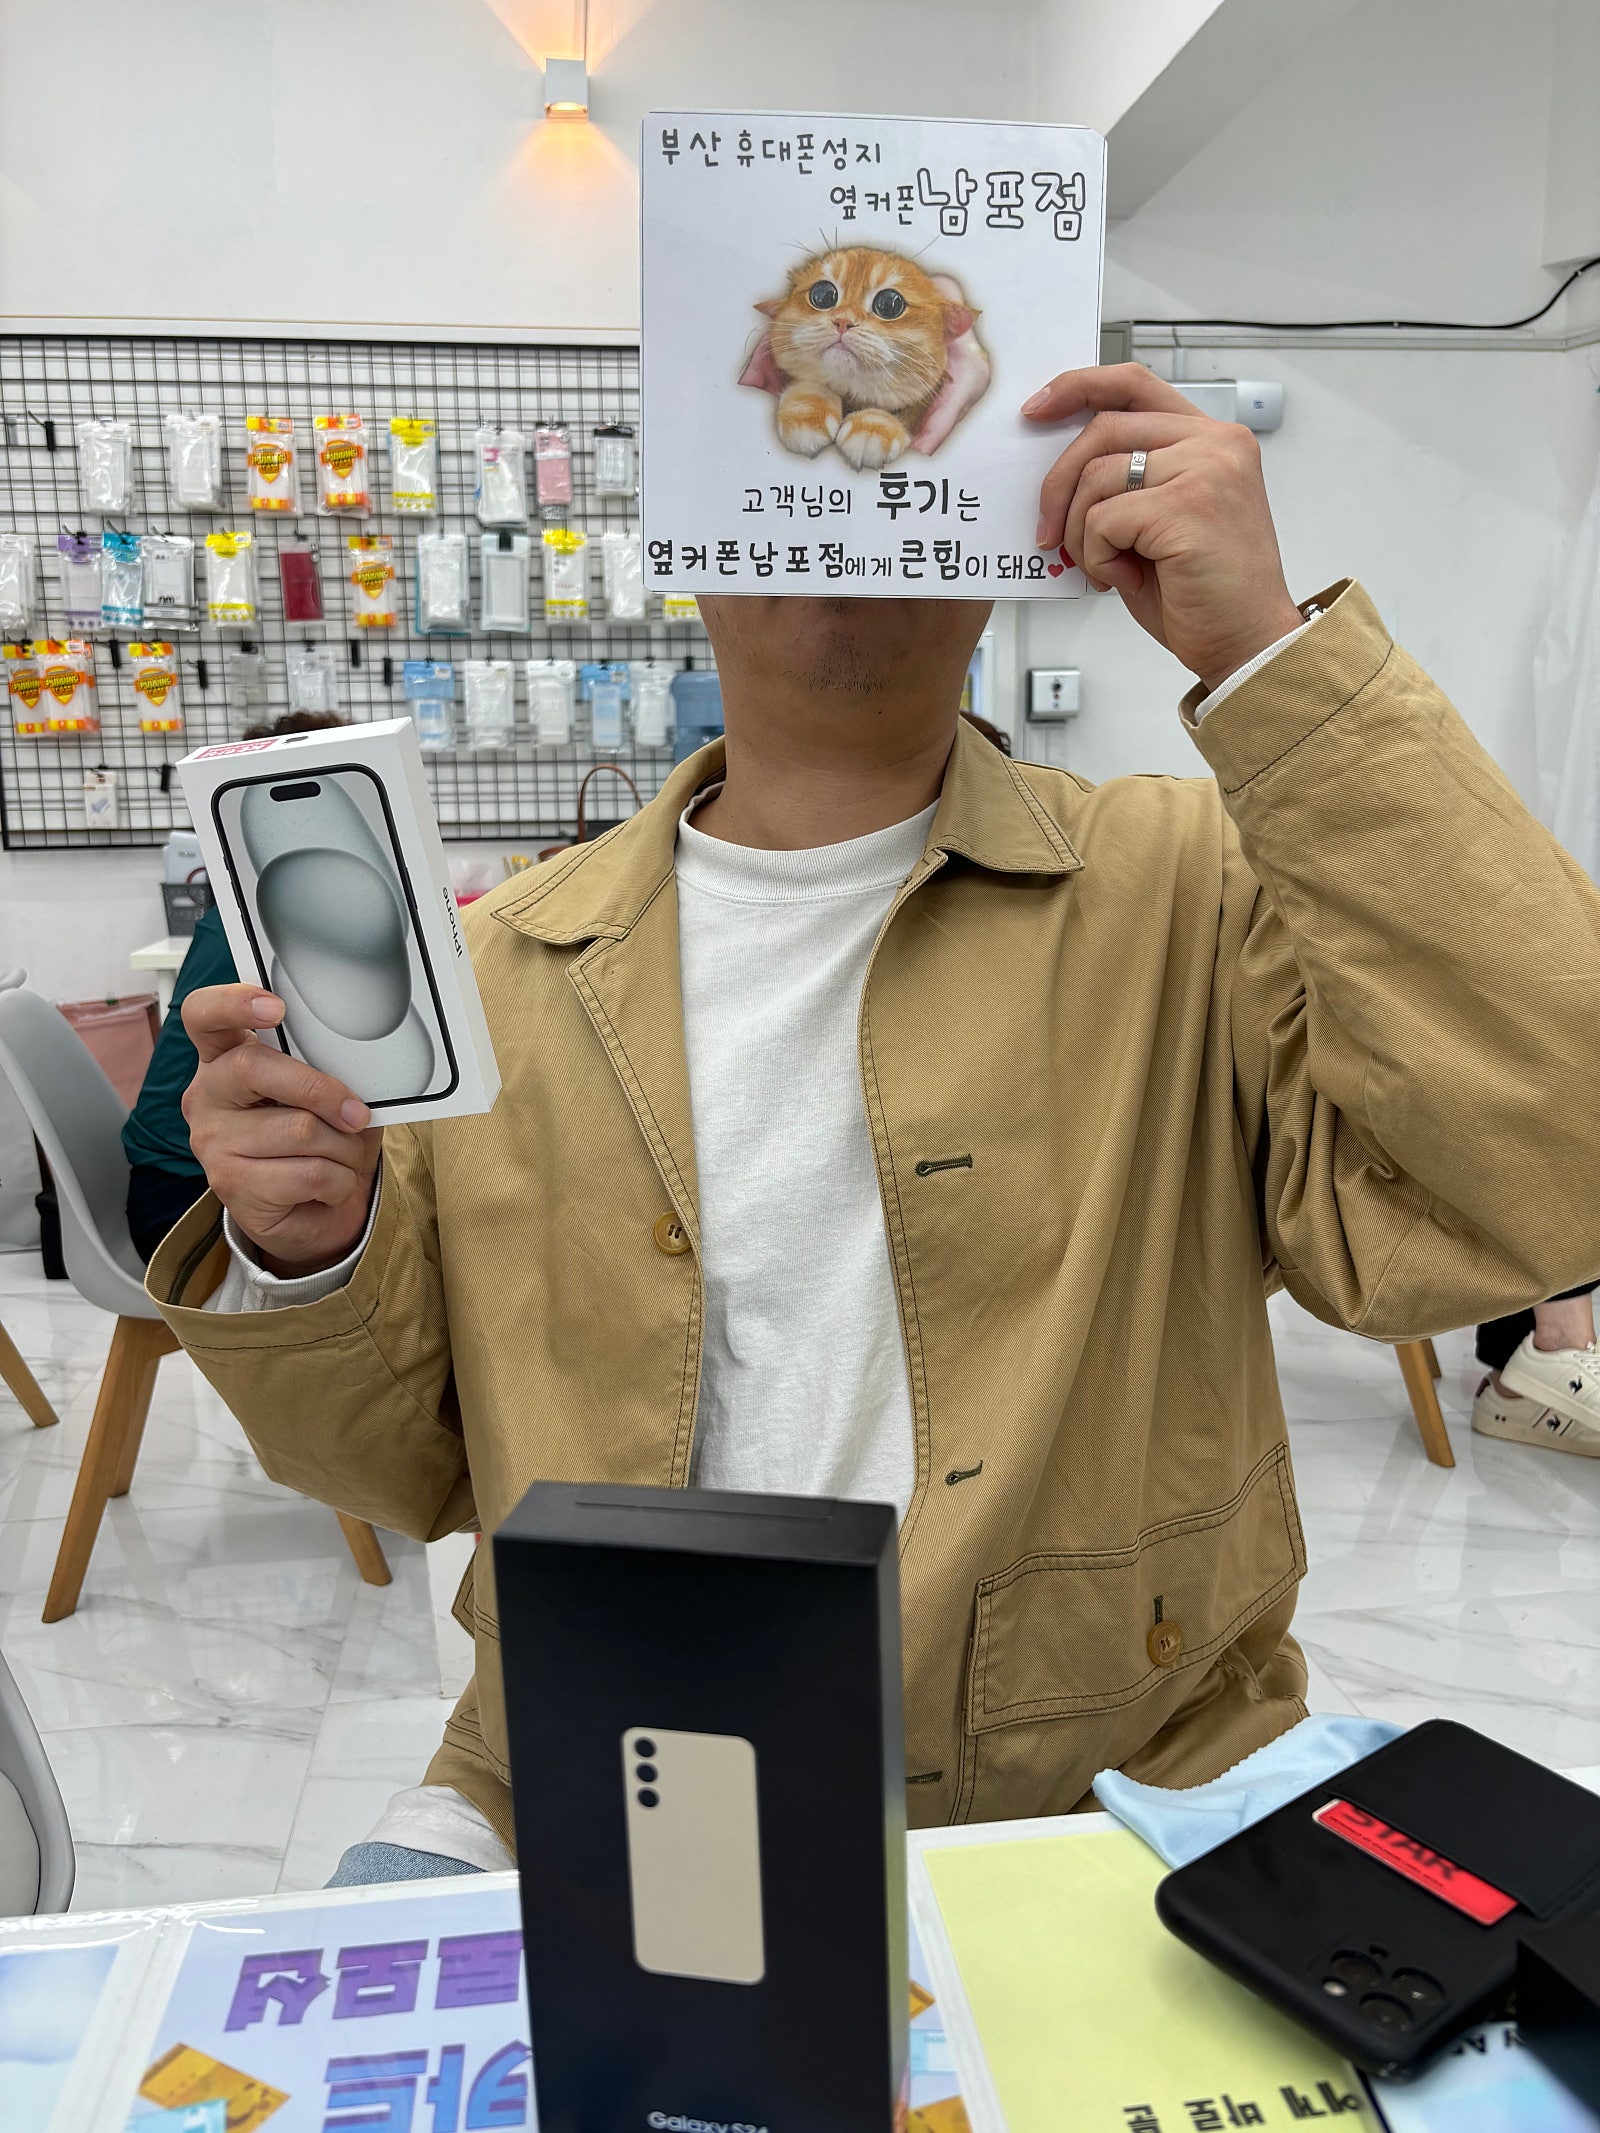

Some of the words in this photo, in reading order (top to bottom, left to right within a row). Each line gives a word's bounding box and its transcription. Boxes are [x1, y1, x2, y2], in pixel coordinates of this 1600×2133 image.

[661, 128, 722, 167] 부산
[736, 129, 881, 175] 휴대폰성지
[742, 485, 852, 518] 고객님의
[876, 471, 981, 522] 후기는
[996, 554, 1047, 580] 돼요
[442, 886, 463, 958] iPhone
[321, 2039, 533, 2133] 카드
[1279, 2081, 1363, 2121] 에게
[647, 2111, 728, 2133] Galaxy
[1184, 2094, 1265, 2132] 바로
